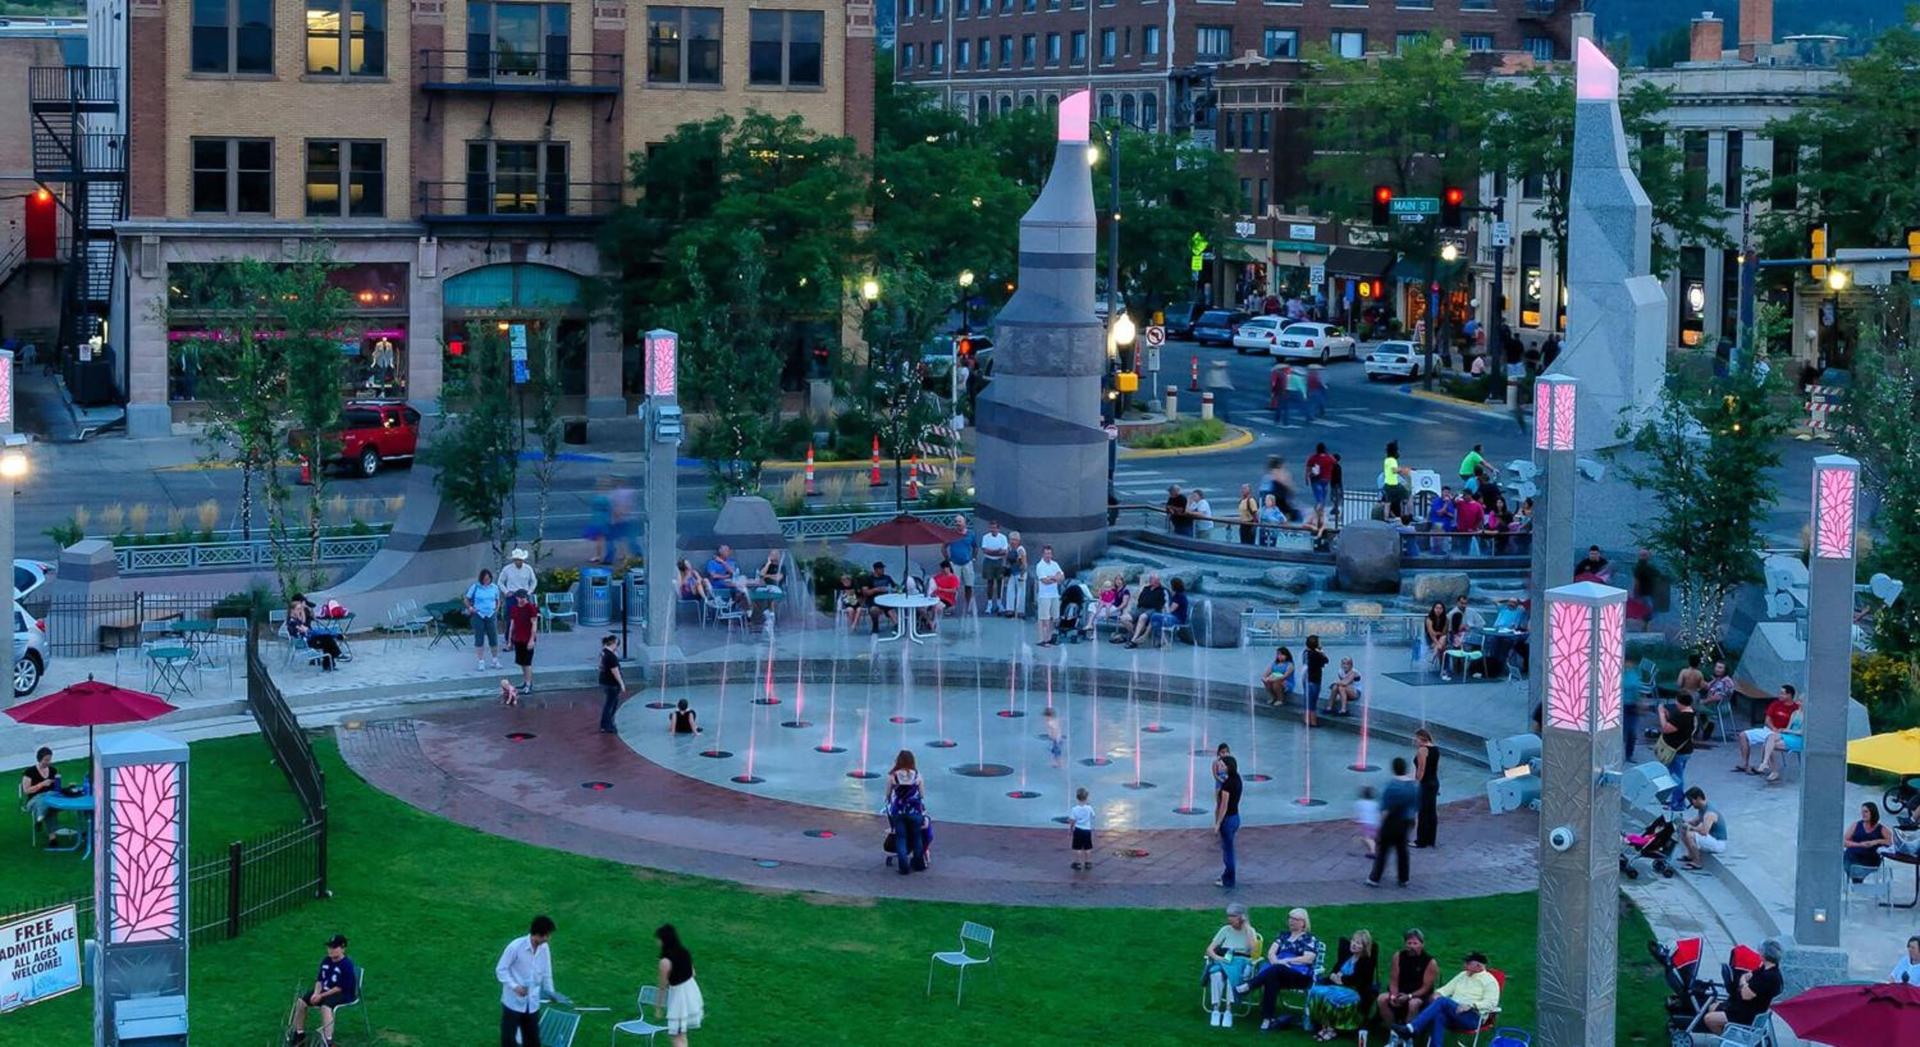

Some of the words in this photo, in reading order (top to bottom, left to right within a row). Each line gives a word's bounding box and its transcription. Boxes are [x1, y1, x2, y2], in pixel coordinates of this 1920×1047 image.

[1394, 201, 1416, 210] MAIN
[1419, 201, 1430, 210] ST
[15, 918, 53, 942] FREE
[0, 927, 74, 961] ADMITTANCE
[12, 957, 62, 981] WELCOME!
[14, 956, 30, 969] ALL
[33, 947, 58, 963] AGES
